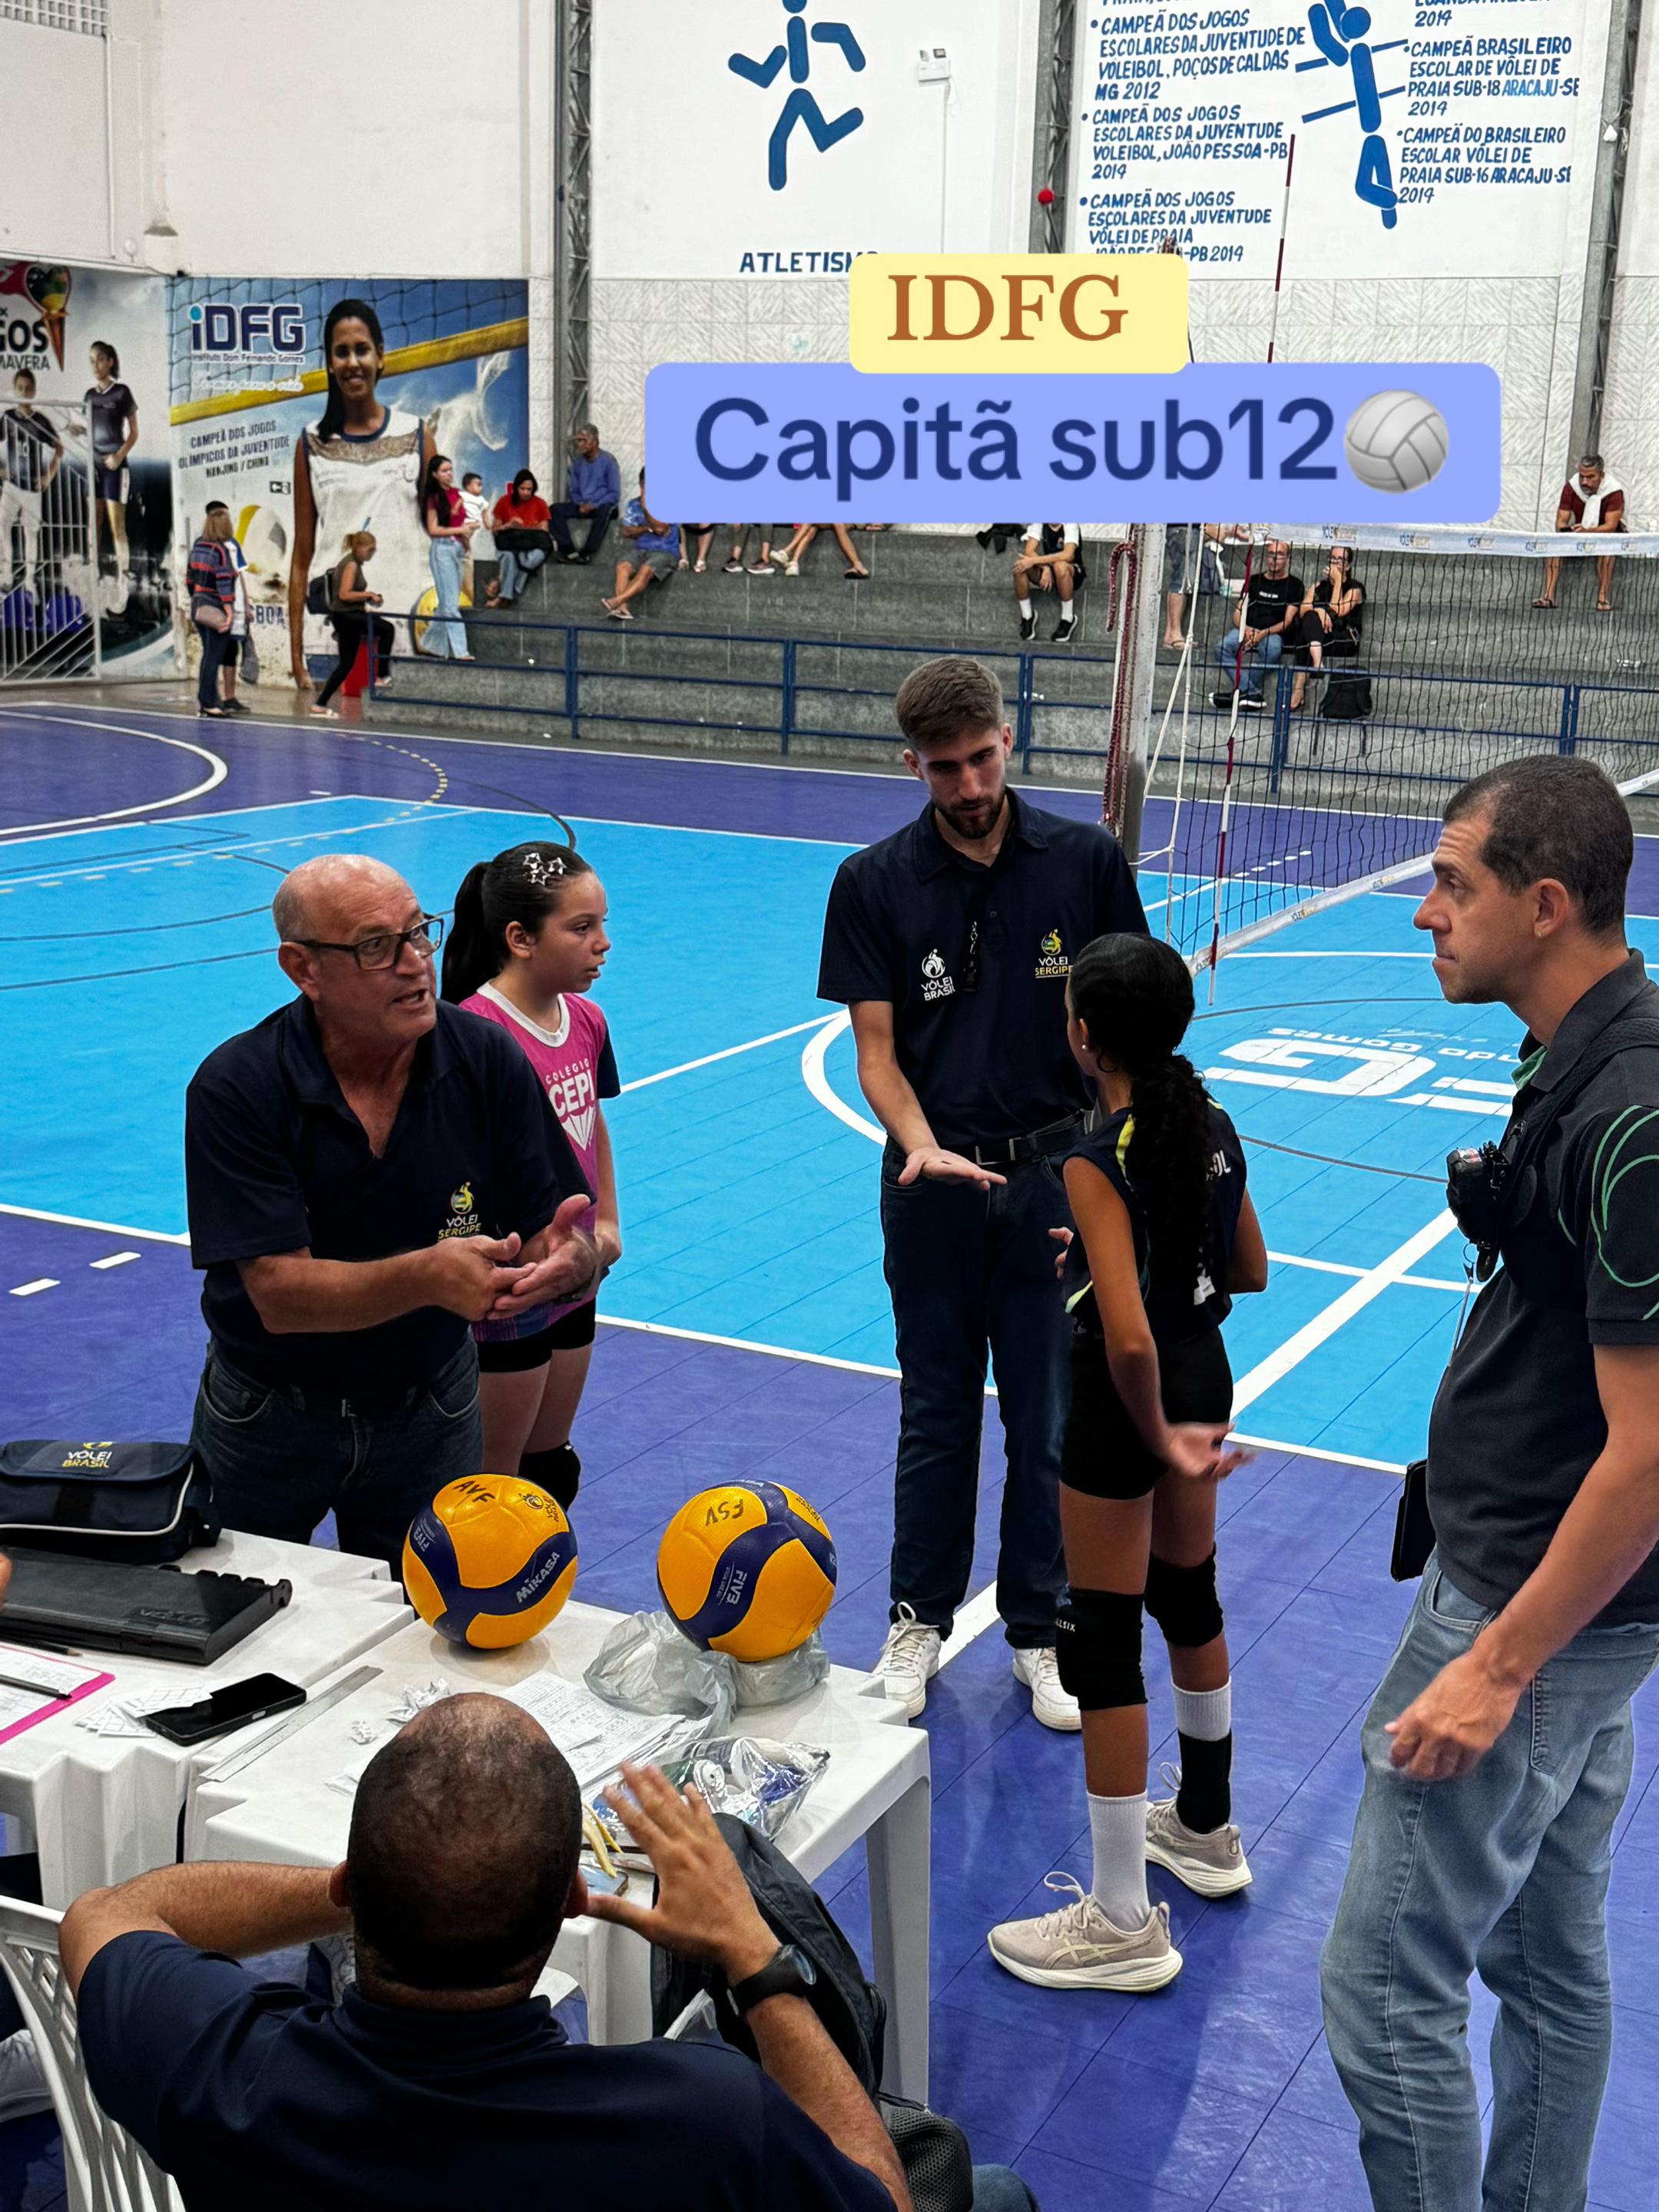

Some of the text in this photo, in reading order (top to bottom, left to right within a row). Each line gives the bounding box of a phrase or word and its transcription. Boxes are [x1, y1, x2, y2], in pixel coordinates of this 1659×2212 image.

[1101, 8, 1250, 35] CAMPEÃ DOS JOGOS
[1414, 10, 1452, 27] 2014
[1100, 26, 1306, 58] ESCOLARES DA JUVENTUDE DE
[1411, 35, 1572, 57] CAMPEÃ BRASILEIRO
[1173, 55, 1217, 80] POÇOS
[1220, 55, 1235, 75] DE
[1236, 49, 1290, 73] CALDAS
[1409, 55, 1561, 78] ESCOLAR DE VÔLEI DE
[1094, 81, 1161, 101] MG 2012
[1408, 80, 1450, 98] PRAIA
[1453, 80, 1500, 97] SUB-18
[1092, 103, 1241, 125] CAMPEÃ DOS JOGOS
[1408, 101, 1448, 116] 2014
[1094, 121, 1283, 143] ESCOLARES DA JUVENTUDE
[1403, 123, 1566, 144] CAMPEÃ DO BRASILEIRO
[1163, 140, 1201, 160] JOÃO
[1401, 147, 1461, 164] ESCOLAR
[1511, 147, 1532, 164] DE
[1091, 164, 1127, 180] 2014
[1399, 167, 1442, 184] PRAIA
[1445, 166, 1489, 184] SUB-16
[1090, 188, 1236, 209] CAMPEÃ DOS JOGOS
[1398, 187, 1435, 204] 2014
[1088, 209, 1272, 227] ESCOLARES DA JUVENTUDE
[1131, 229, 1149, 244] DE
[739, 251, 878, 273] ATLETIS
[1210, 245, 1243, 262] 2014
[228, 426, 246, 441] DOS
[240, 435, 290, 456] JUVENTUDE
[1038, 955, 1068, 967] VÔLEI
[921, 976, 953, 992] VÔLEI
[924, 985, 956, 1002] BRASIL
[548, 1069, 595, 1118] CEPI
[446, 1214, 478, 1227] VÔLEI
[438, 1223, 482, 1239] SERGIPE
[61, 1459, 110, 1468] BRASIL
